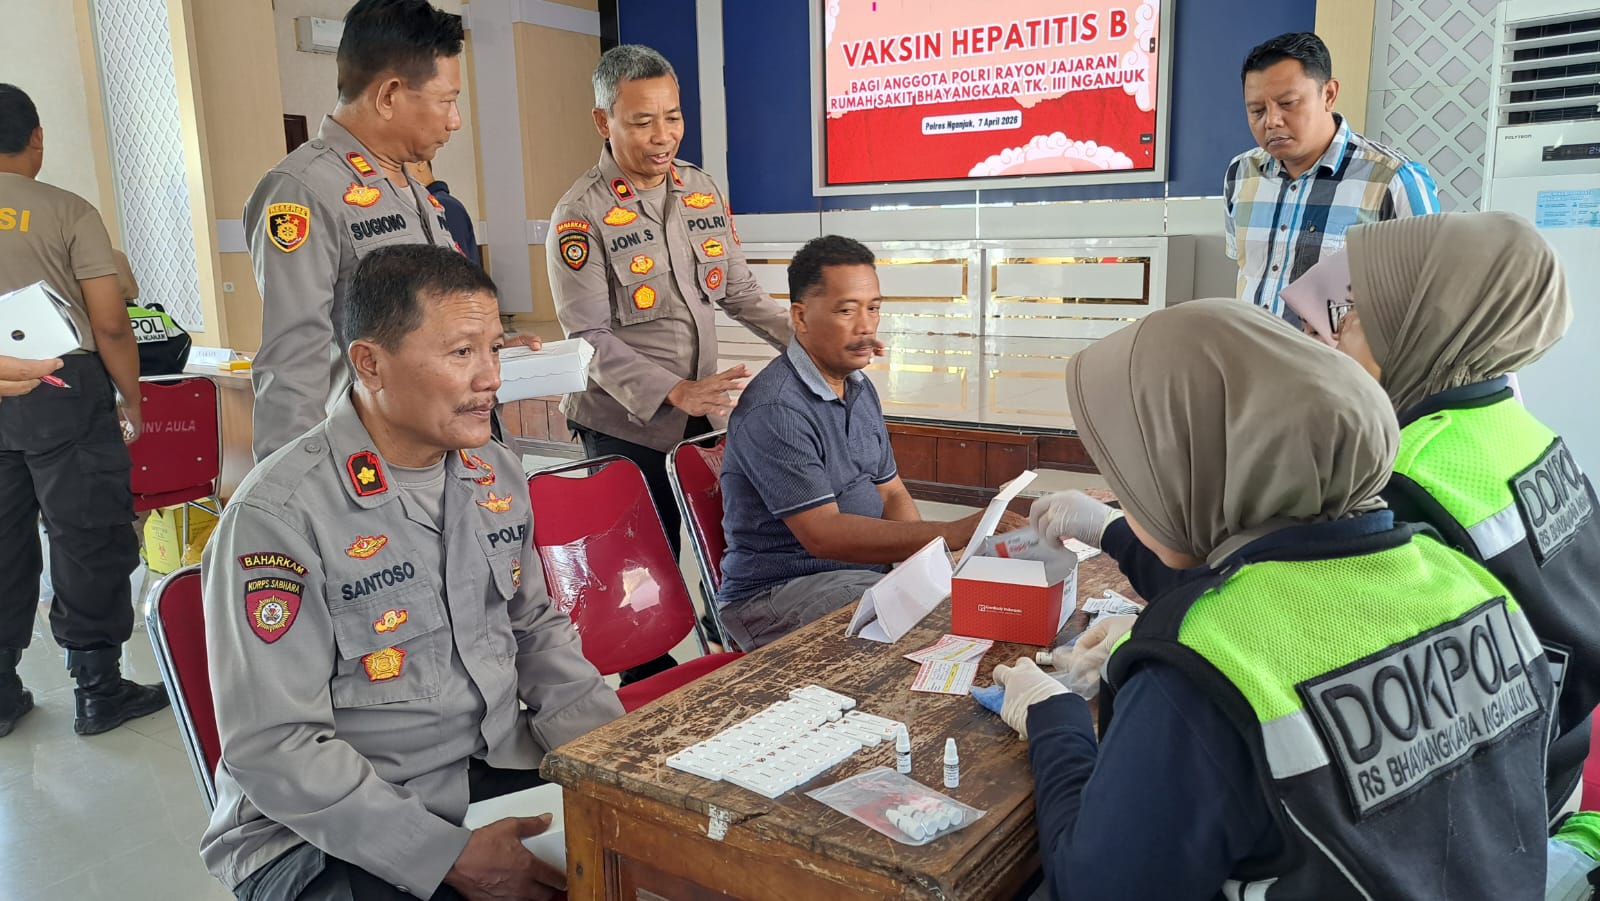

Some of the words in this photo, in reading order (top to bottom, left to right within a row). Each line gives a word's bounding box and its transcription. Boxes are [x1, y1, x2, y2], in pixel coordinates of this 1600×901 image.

[842, 33, 942, 67] VAKSIN
[952, 13, 1098, 55] HEPATITIS
[1110, 10, 1128, 38] B
[851, 80, 881, 94] BAGI
[884, 74, 948, 91] ANGGOTA
[952, 68, 992, 84] POLRI
[995, 62, 1046, 79] RAYON
[1050, 55, 1118, 76] JAJARAN
[831, 95, 875, 109] RUMAH
[876, 91, 914, 106] SAKIT
[917, 84, 1021, 103] BHAYANGKARA
[1025, 78, 1048, 94] TK.
[1052, 76, 1067, 91] III
[1071, 69, 1145, 89] NGANJUK
[925, 121, 945, 131] Polres
[978, 118, 983, 127] 7
[984, 117, 1000, 128] April
[1001, 116, 1018, 125] 2026
[350, 213, 407, 241] SUGIONO
[687, 215, 726, 232] POLRI
[610, 232, 642, 252] JONI
[165, 420, 196, 433] AULA
[487, 524, 526, 549] POLR
[244, 554, 305, 575] BAHARKAM
[247, 579, 271, 592] KORPS
[270, 579, 300, 595] SABHARA
[341, 561, 416, 601] SANTOSO
[1320, 614, 1522, 765] DOKPOL
[1359, 766, 1386, 803] RS
[1387, 713, 1482, 787] BHAYANGKARA
